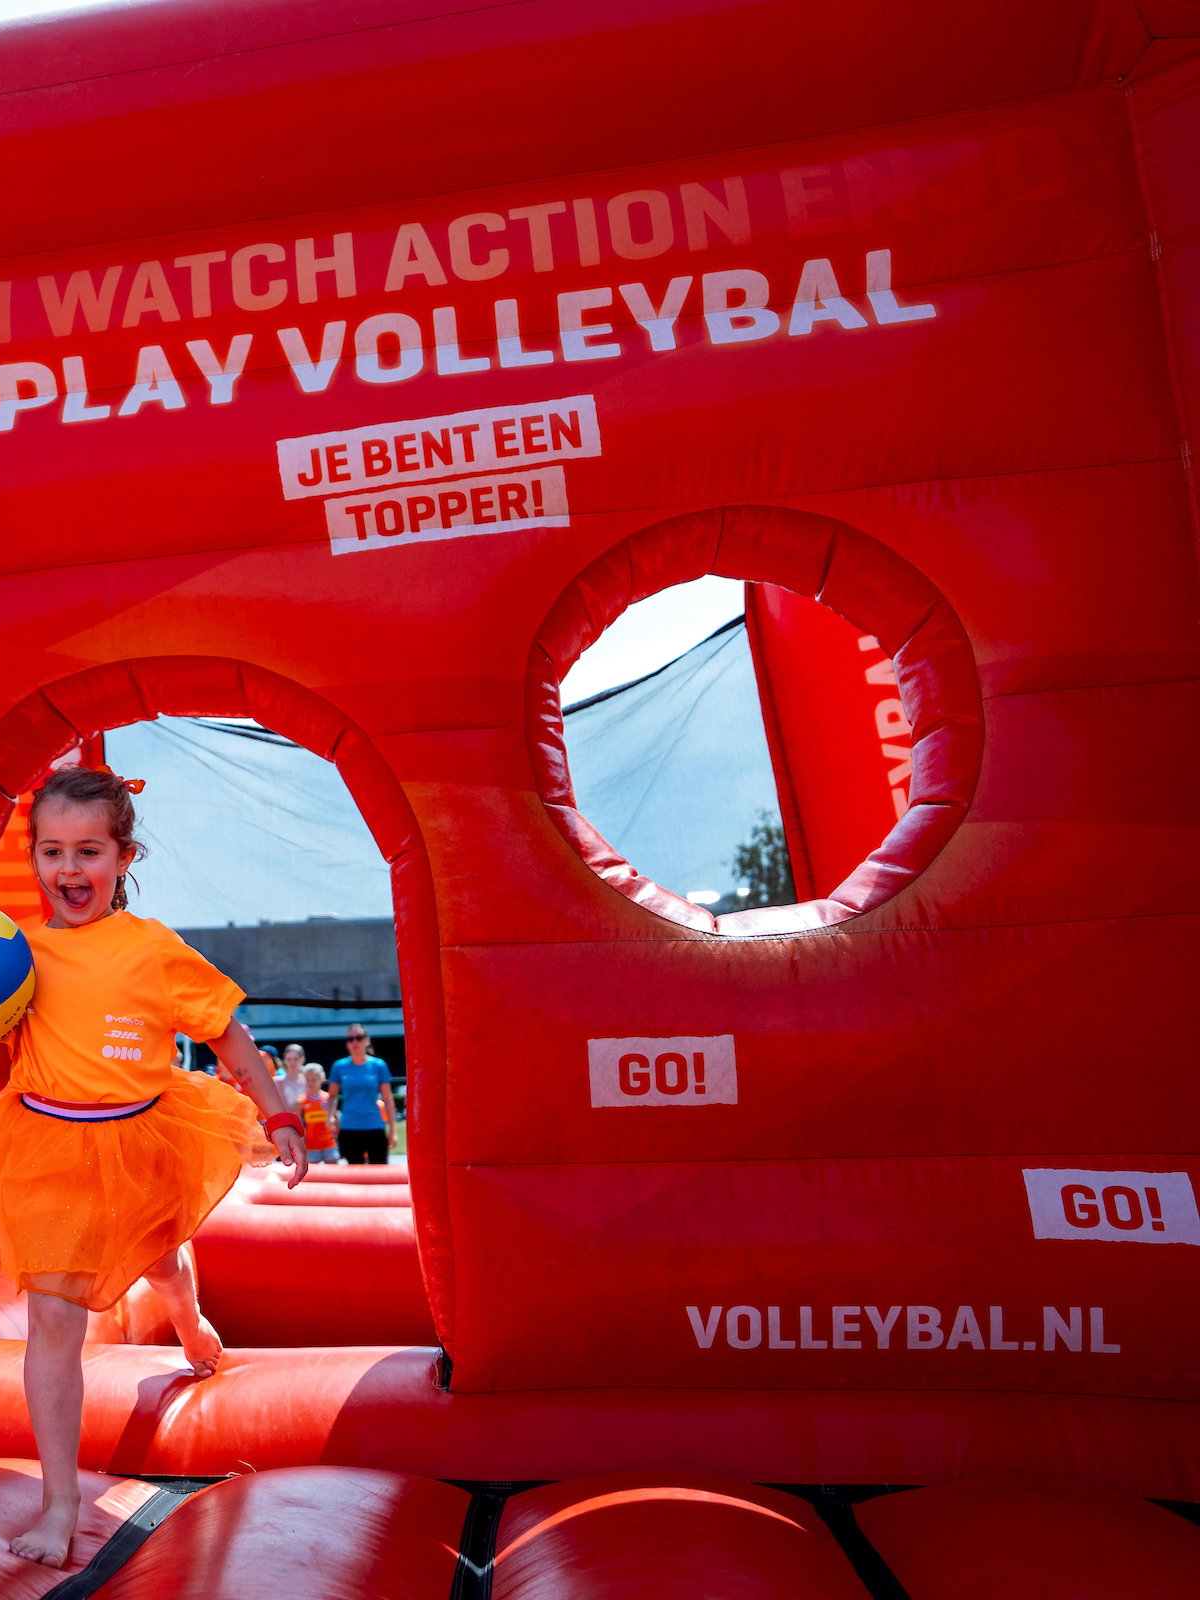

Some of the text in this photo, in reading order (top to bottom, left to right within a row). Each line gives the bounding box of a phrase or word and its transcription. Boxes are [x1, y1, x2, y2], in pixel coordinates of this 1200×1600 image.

[38, 231, 357, 337] WATCH
[383, 175, 753, 293] ACTION
[276, 248, 936, 394] VOLLEYBAL
[297, 410, 583, 487] JE BENT EEN
[344, 480, 543, 541] TOPPER!
[618, 1052, 706, 1096] GO!
[1060, 1184, 1165, 1232] GO!
[686, 1305, 1121, 1353] VOLLEYBAL.NL
